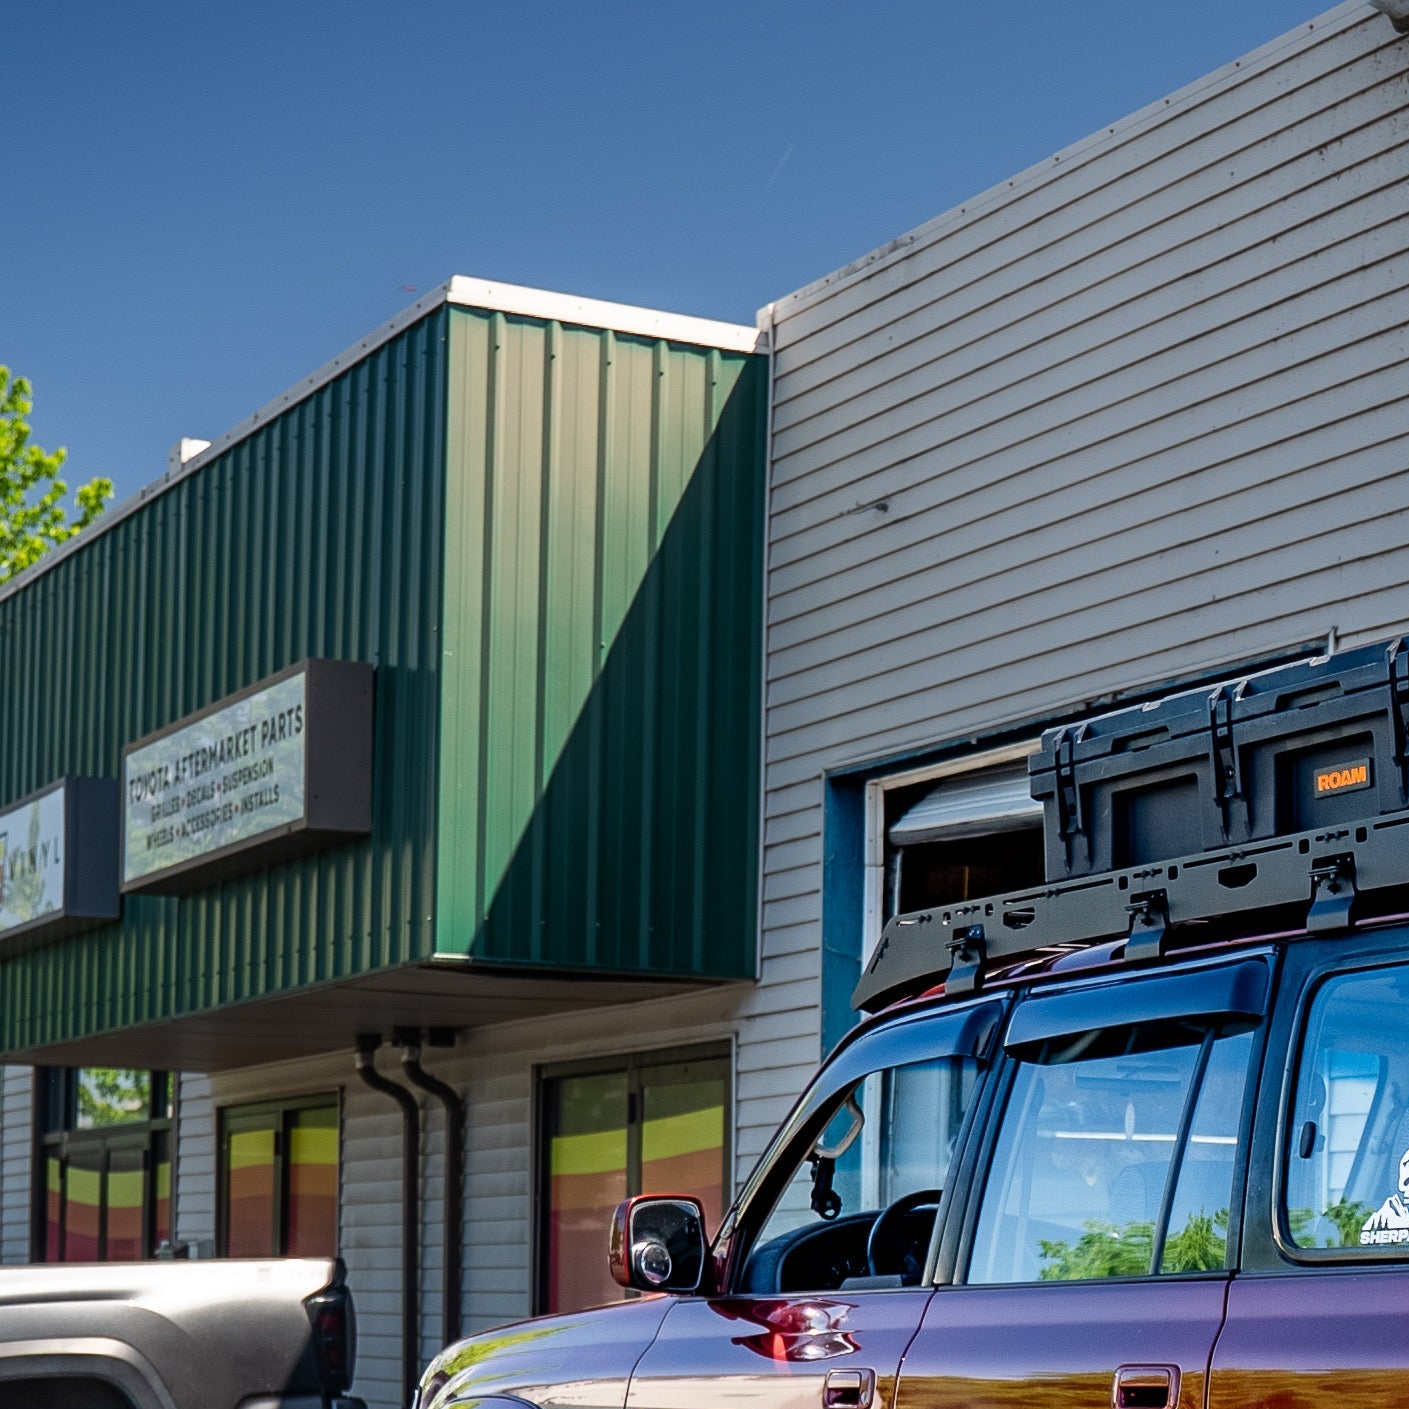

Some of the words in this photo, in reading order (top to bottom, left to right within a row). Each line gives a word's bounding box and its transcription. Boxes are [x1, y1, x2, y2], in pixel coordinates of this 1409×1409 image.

[129, 765, 171, 805] TOYOTA
[174, 724, 258, 785] AFTERMARKET
[260, 704, 304, 749] PARTS
[222, 756, 275, 795] SUSPENSION
[1317, 765, 1367, 792] ROAM
[240, 784, 281, 816] INSTALLS
